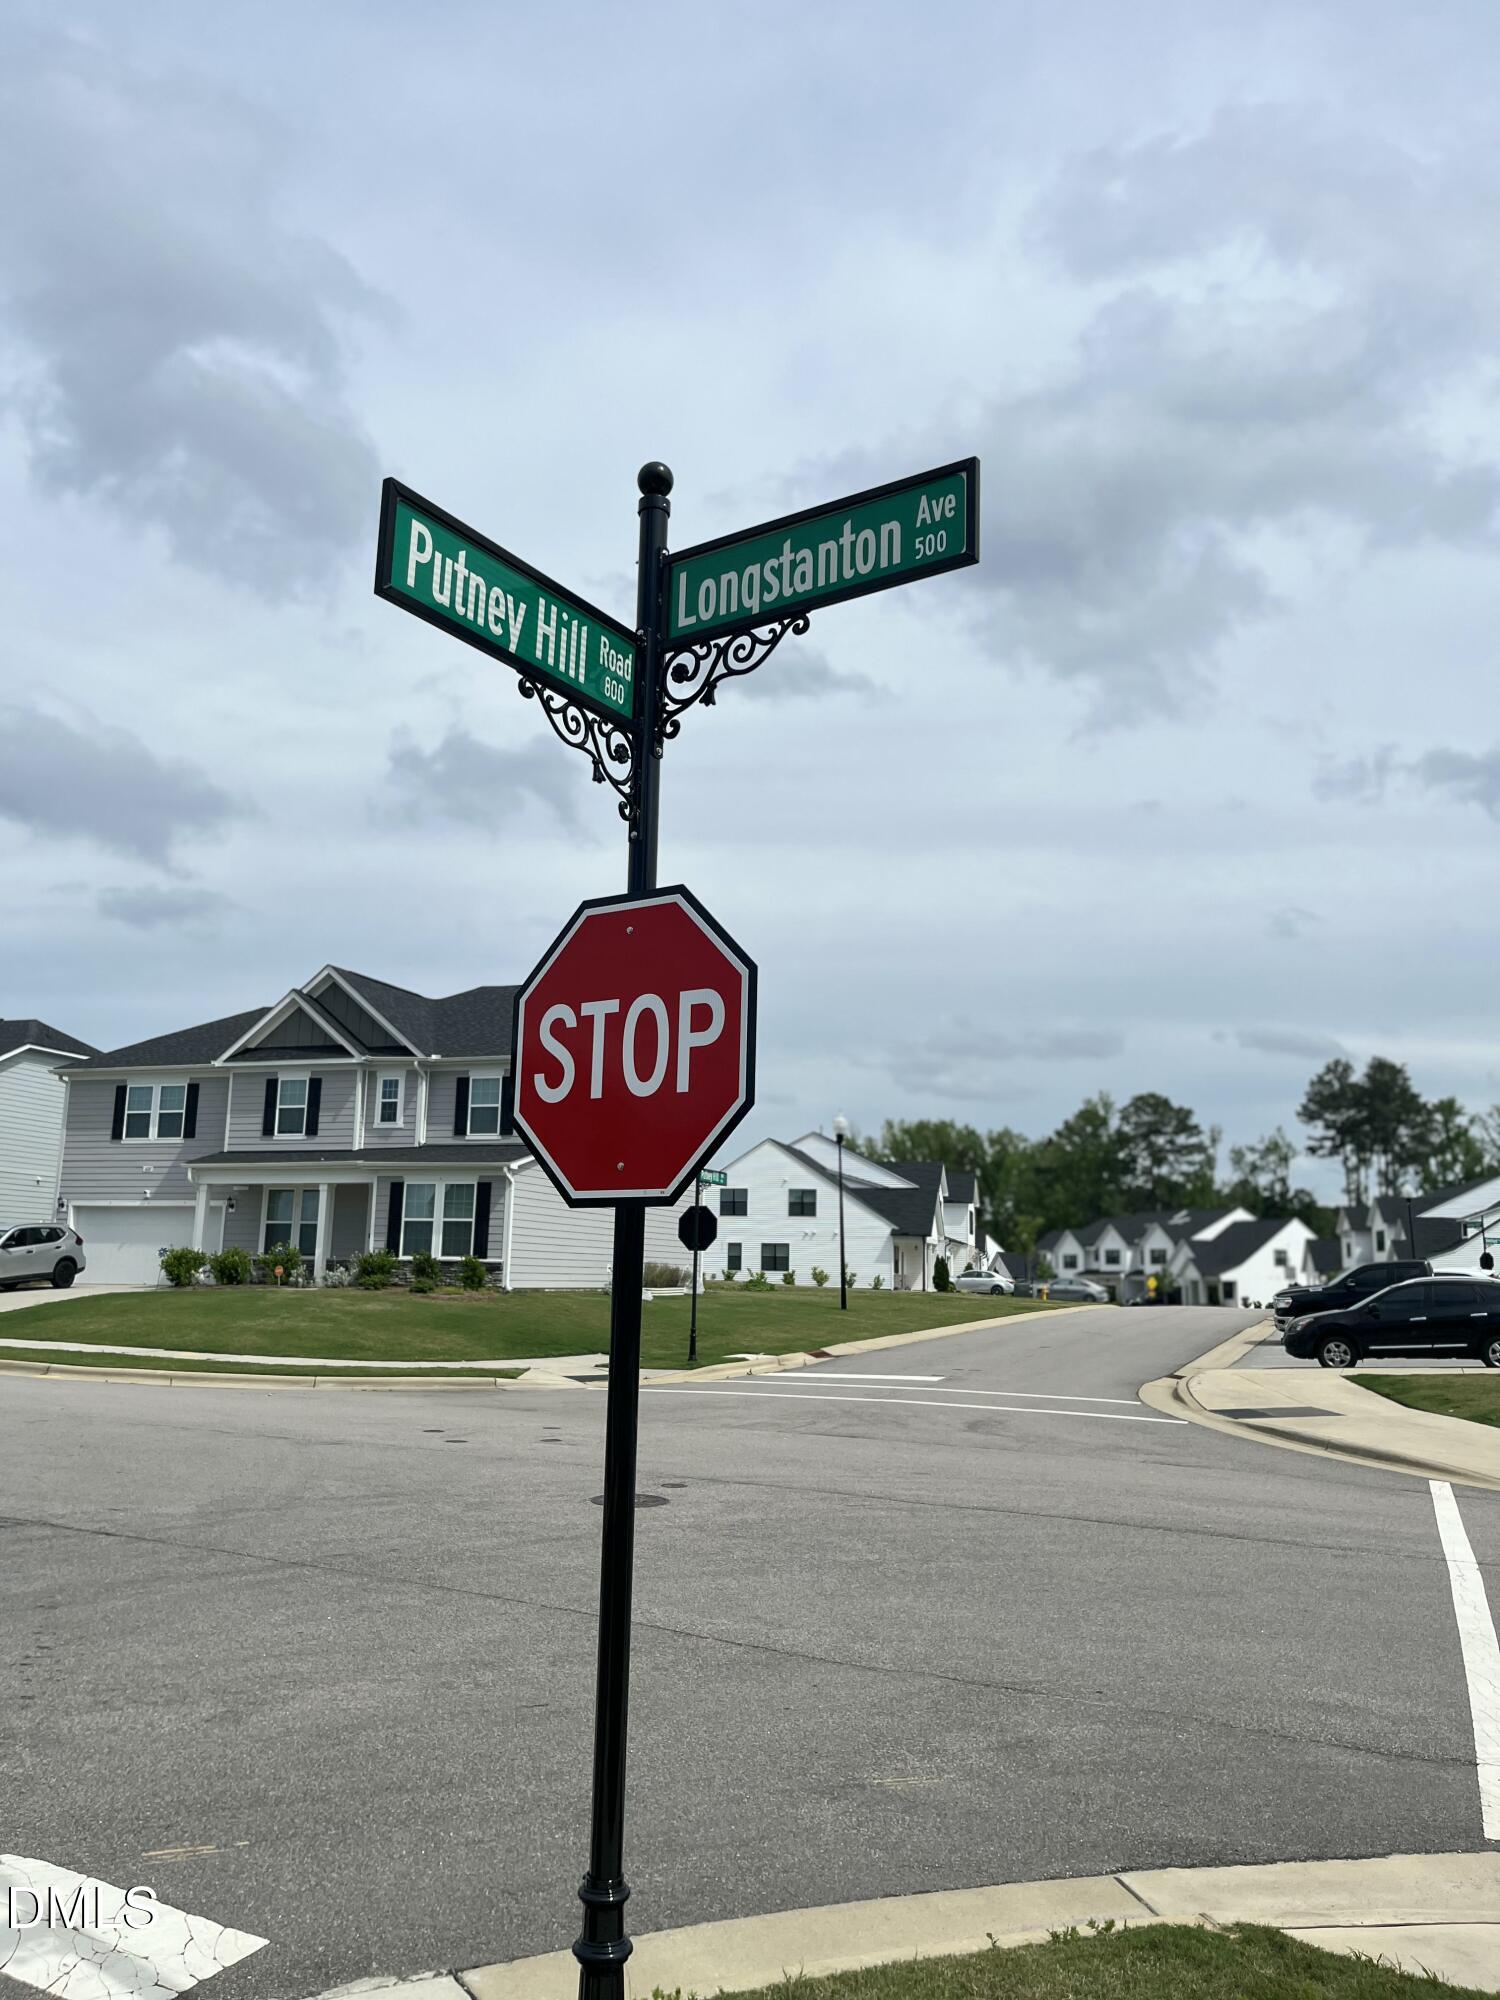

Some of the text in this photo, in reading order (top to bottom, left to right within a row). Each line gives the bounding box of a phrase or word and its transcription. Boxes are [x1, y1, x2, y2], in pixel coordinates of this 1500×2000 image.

[915, 493, 956, 528] Ave
[914, 530, 947, 559] 500
[407, 518, 588, 684] Putney Hill
[600, 635, 632, 682] Road
[604, 676, 624, 704] 800
[533, 988, 726, 1103] STOP
